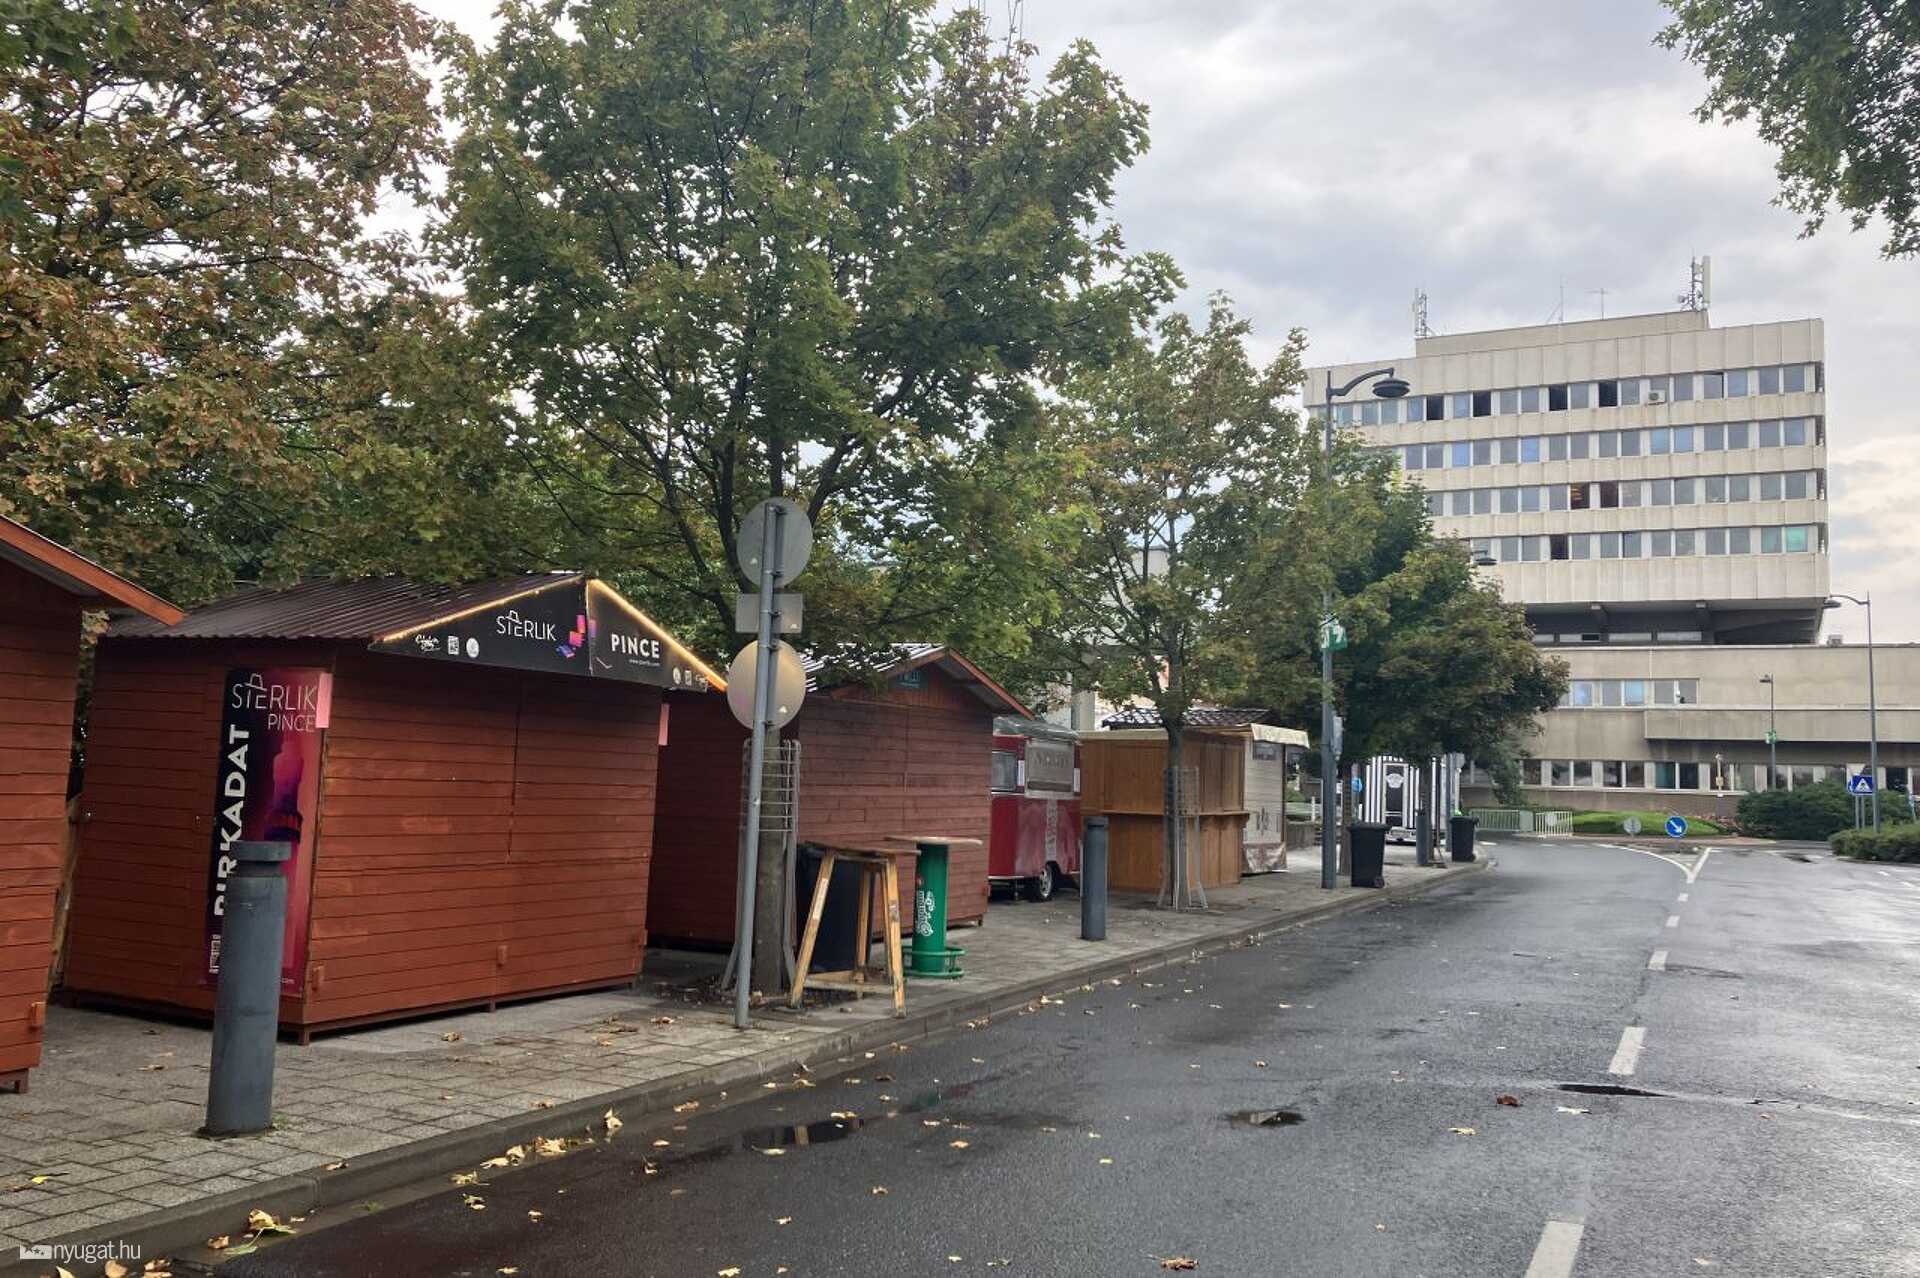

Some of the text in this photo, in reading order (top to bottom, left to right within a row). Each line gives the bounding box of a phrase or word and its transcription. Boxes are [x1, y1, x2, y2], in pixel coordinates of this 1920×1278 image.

[496, 610, 557, 641] STERLIK
[611, 633, 659, 658] PINCE
[232, 674, 317, 710] STERLIK
[267, 713, 315, 732] PINCE
